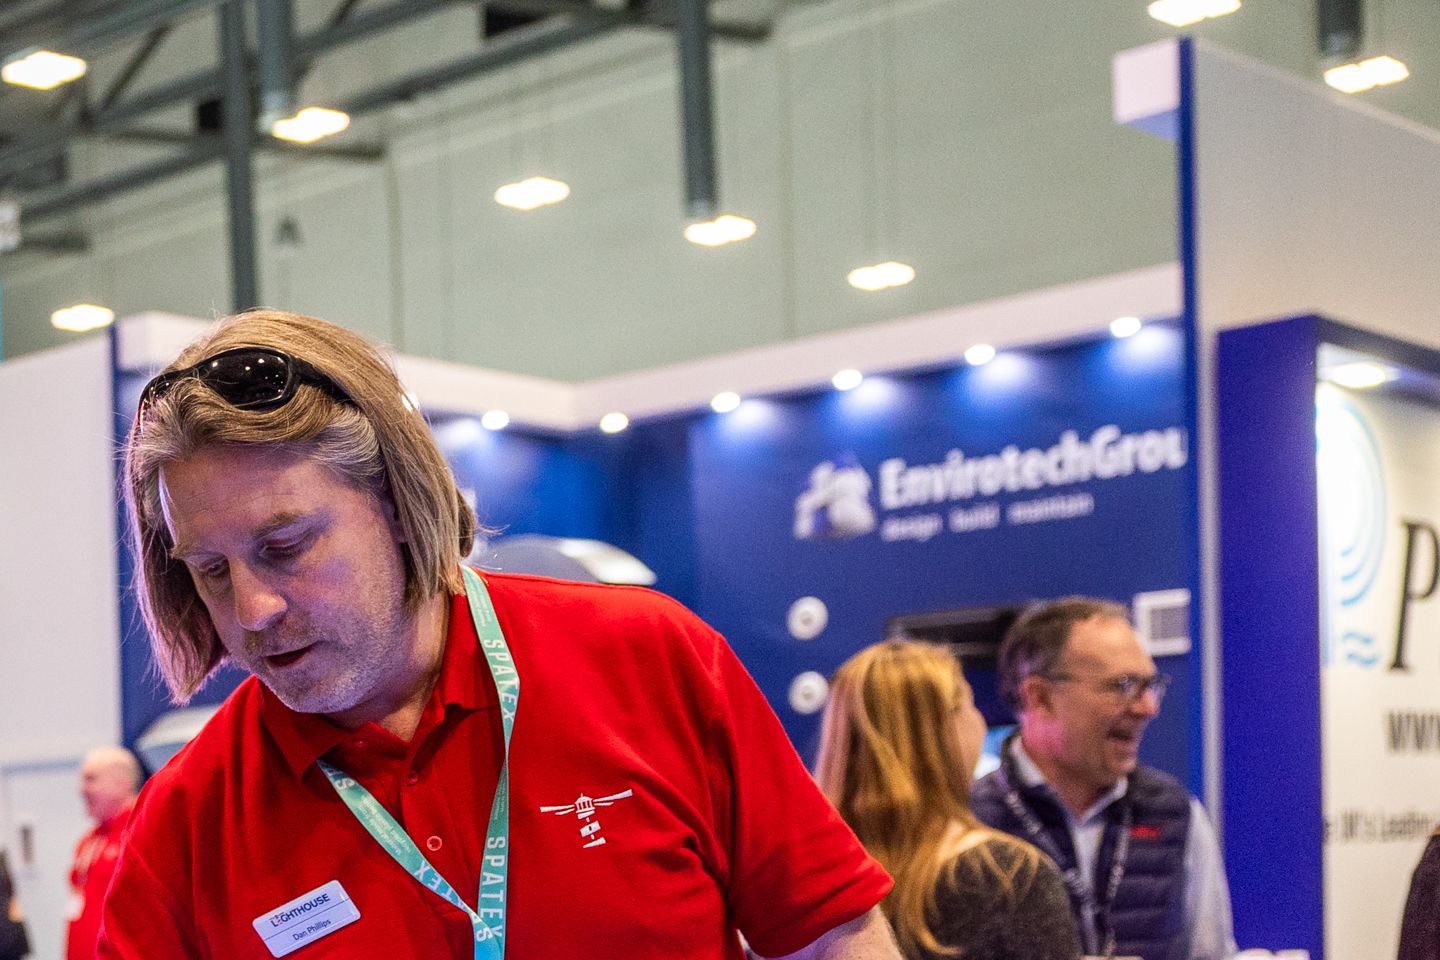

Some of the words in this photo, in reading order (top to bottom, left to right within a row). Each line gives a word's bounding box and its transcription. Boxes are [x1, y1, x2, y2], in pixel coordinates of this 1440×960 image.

[483, 638, 519, 723] SPATEX
[479, 836, 506, 938] SPATEX
[292, 930, 308, 941] Dan
[306, 919, 332, 934] Phillips
